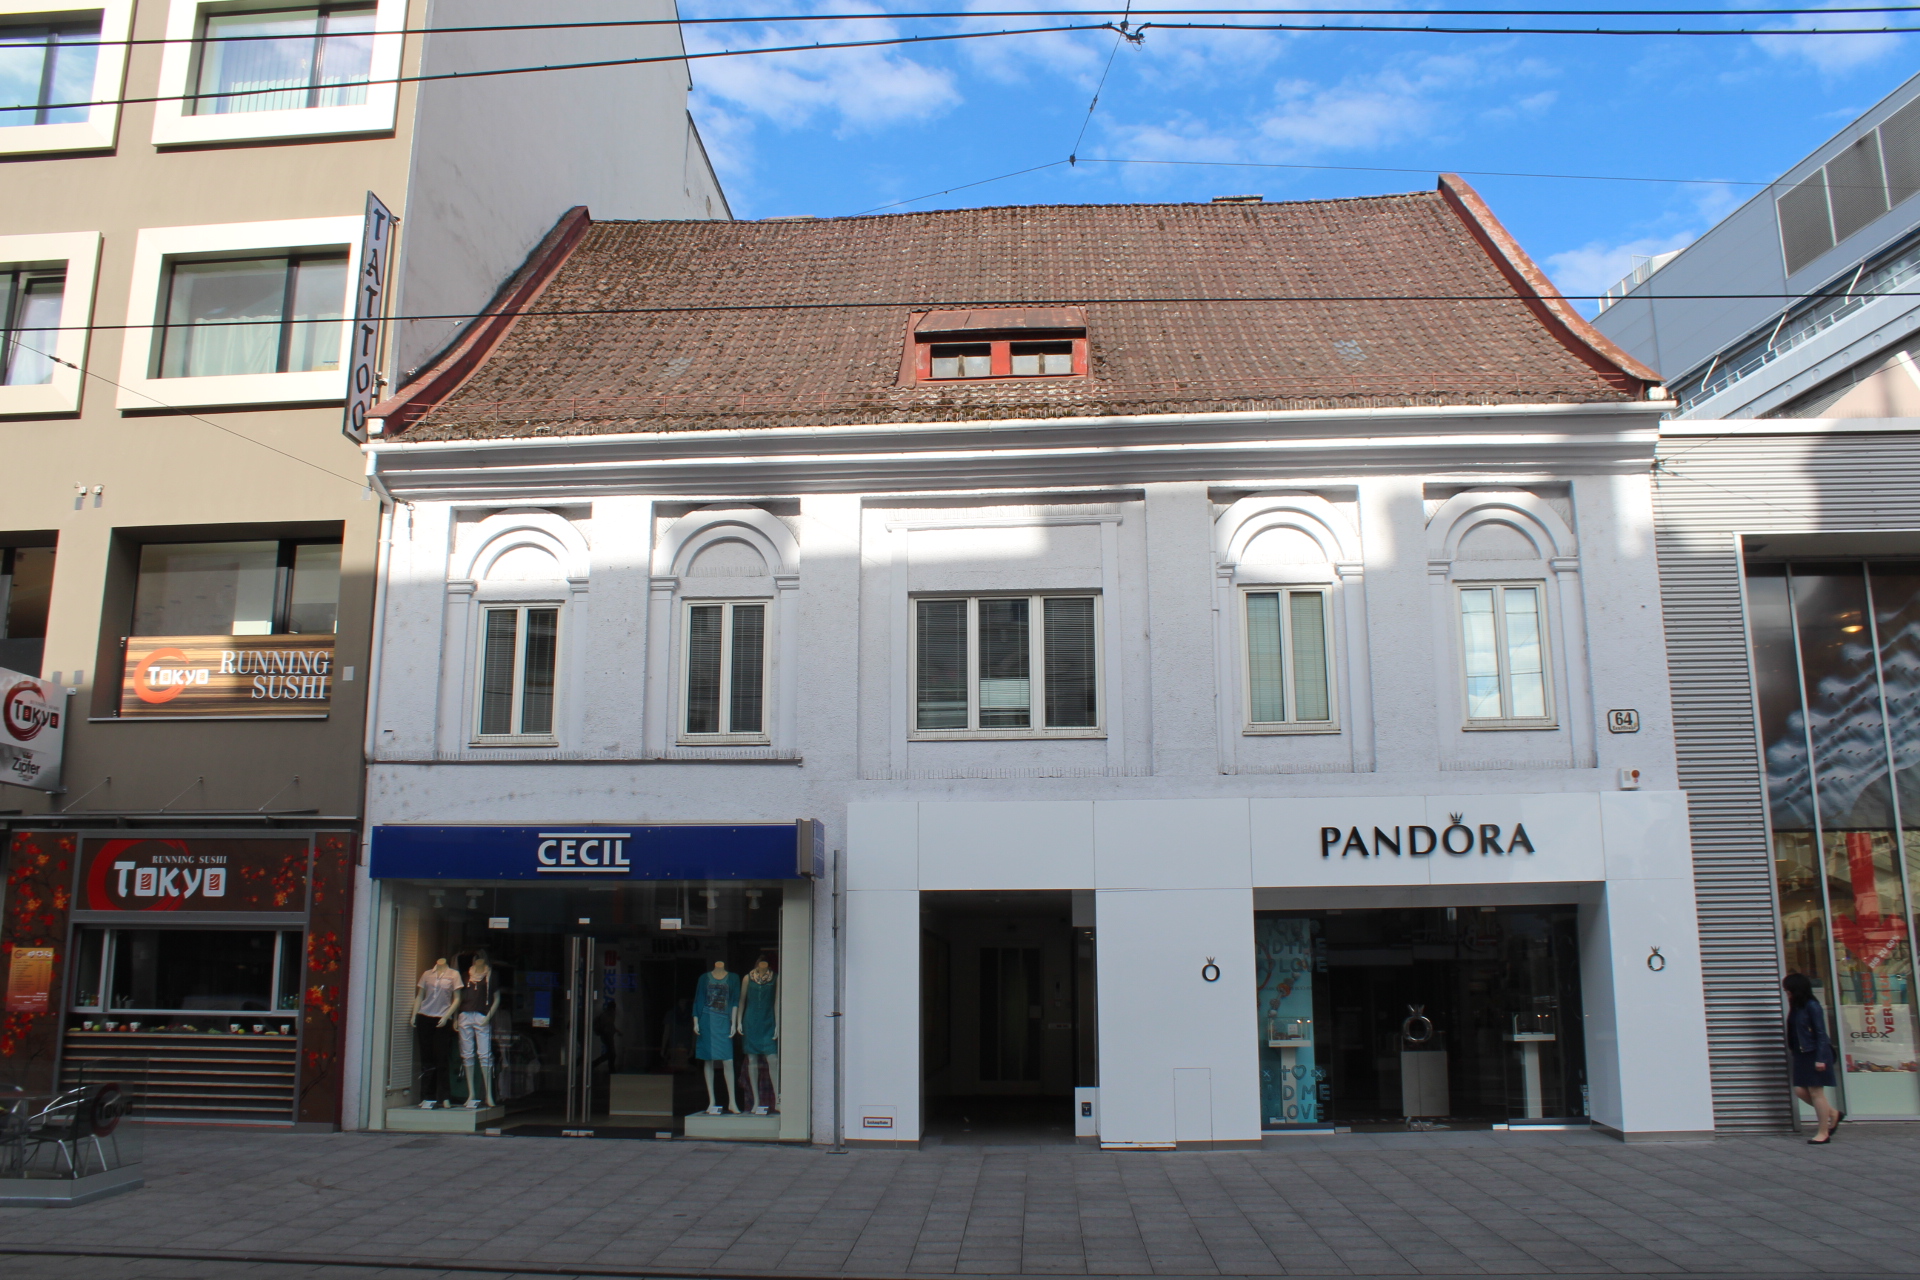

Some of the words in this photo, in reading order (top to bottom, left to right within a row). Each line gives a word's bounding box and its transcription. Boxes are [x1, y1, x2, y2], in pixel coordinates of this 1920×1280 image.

[352, 208, 386, 431] TATTOO
[218, 650, 330, 675] RUNNING
[147, 666, 210, 686] TOKYO
[251, 674, 328, 700] SUSHI
[14, 699, 60, 729] TOKYO
[1615, 711, 1633, 726] 64
[12, 757, 41, 776] Zipfer
[1320, 821, 1536, 858] PANDORA
[152, 855, 195, 864] RUNNING
[198, 855, 228, 864] SUSHI
[537, 839, 631, 866] CECIL
[113, 861, 227, 899] TOKYO
[1868, 956, 1881, 969] BIS
[1850, 1031, 1890, 1040] GEOX
